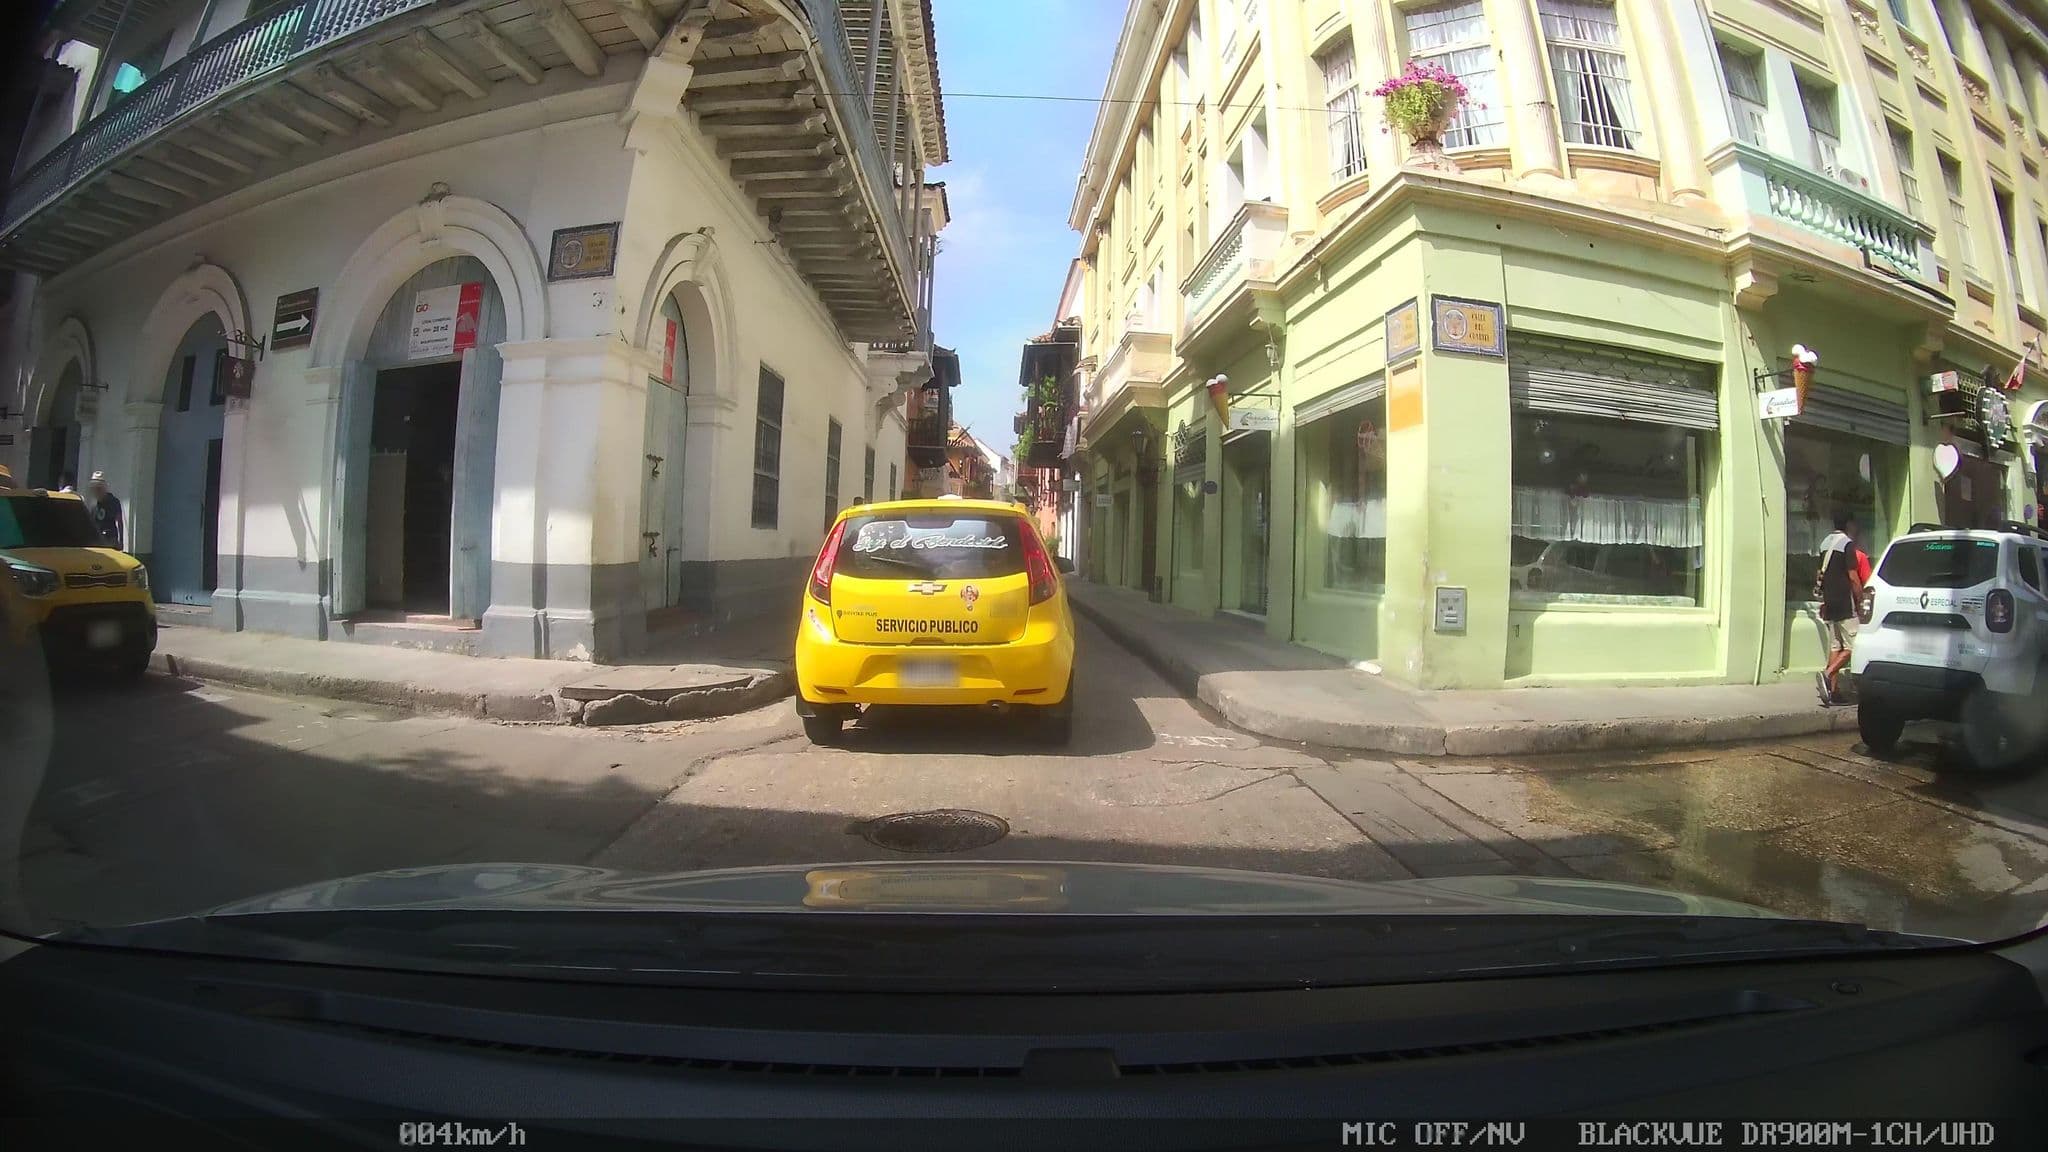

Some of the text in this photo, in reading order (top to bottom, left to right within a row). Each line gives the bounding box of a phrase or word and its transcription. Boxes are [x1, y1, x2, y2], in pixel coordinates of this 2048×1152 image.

[1930, 598, 1958, 608] ESPECIAL
[876, 618, 979, 634] SERVICIO PUBLICO
